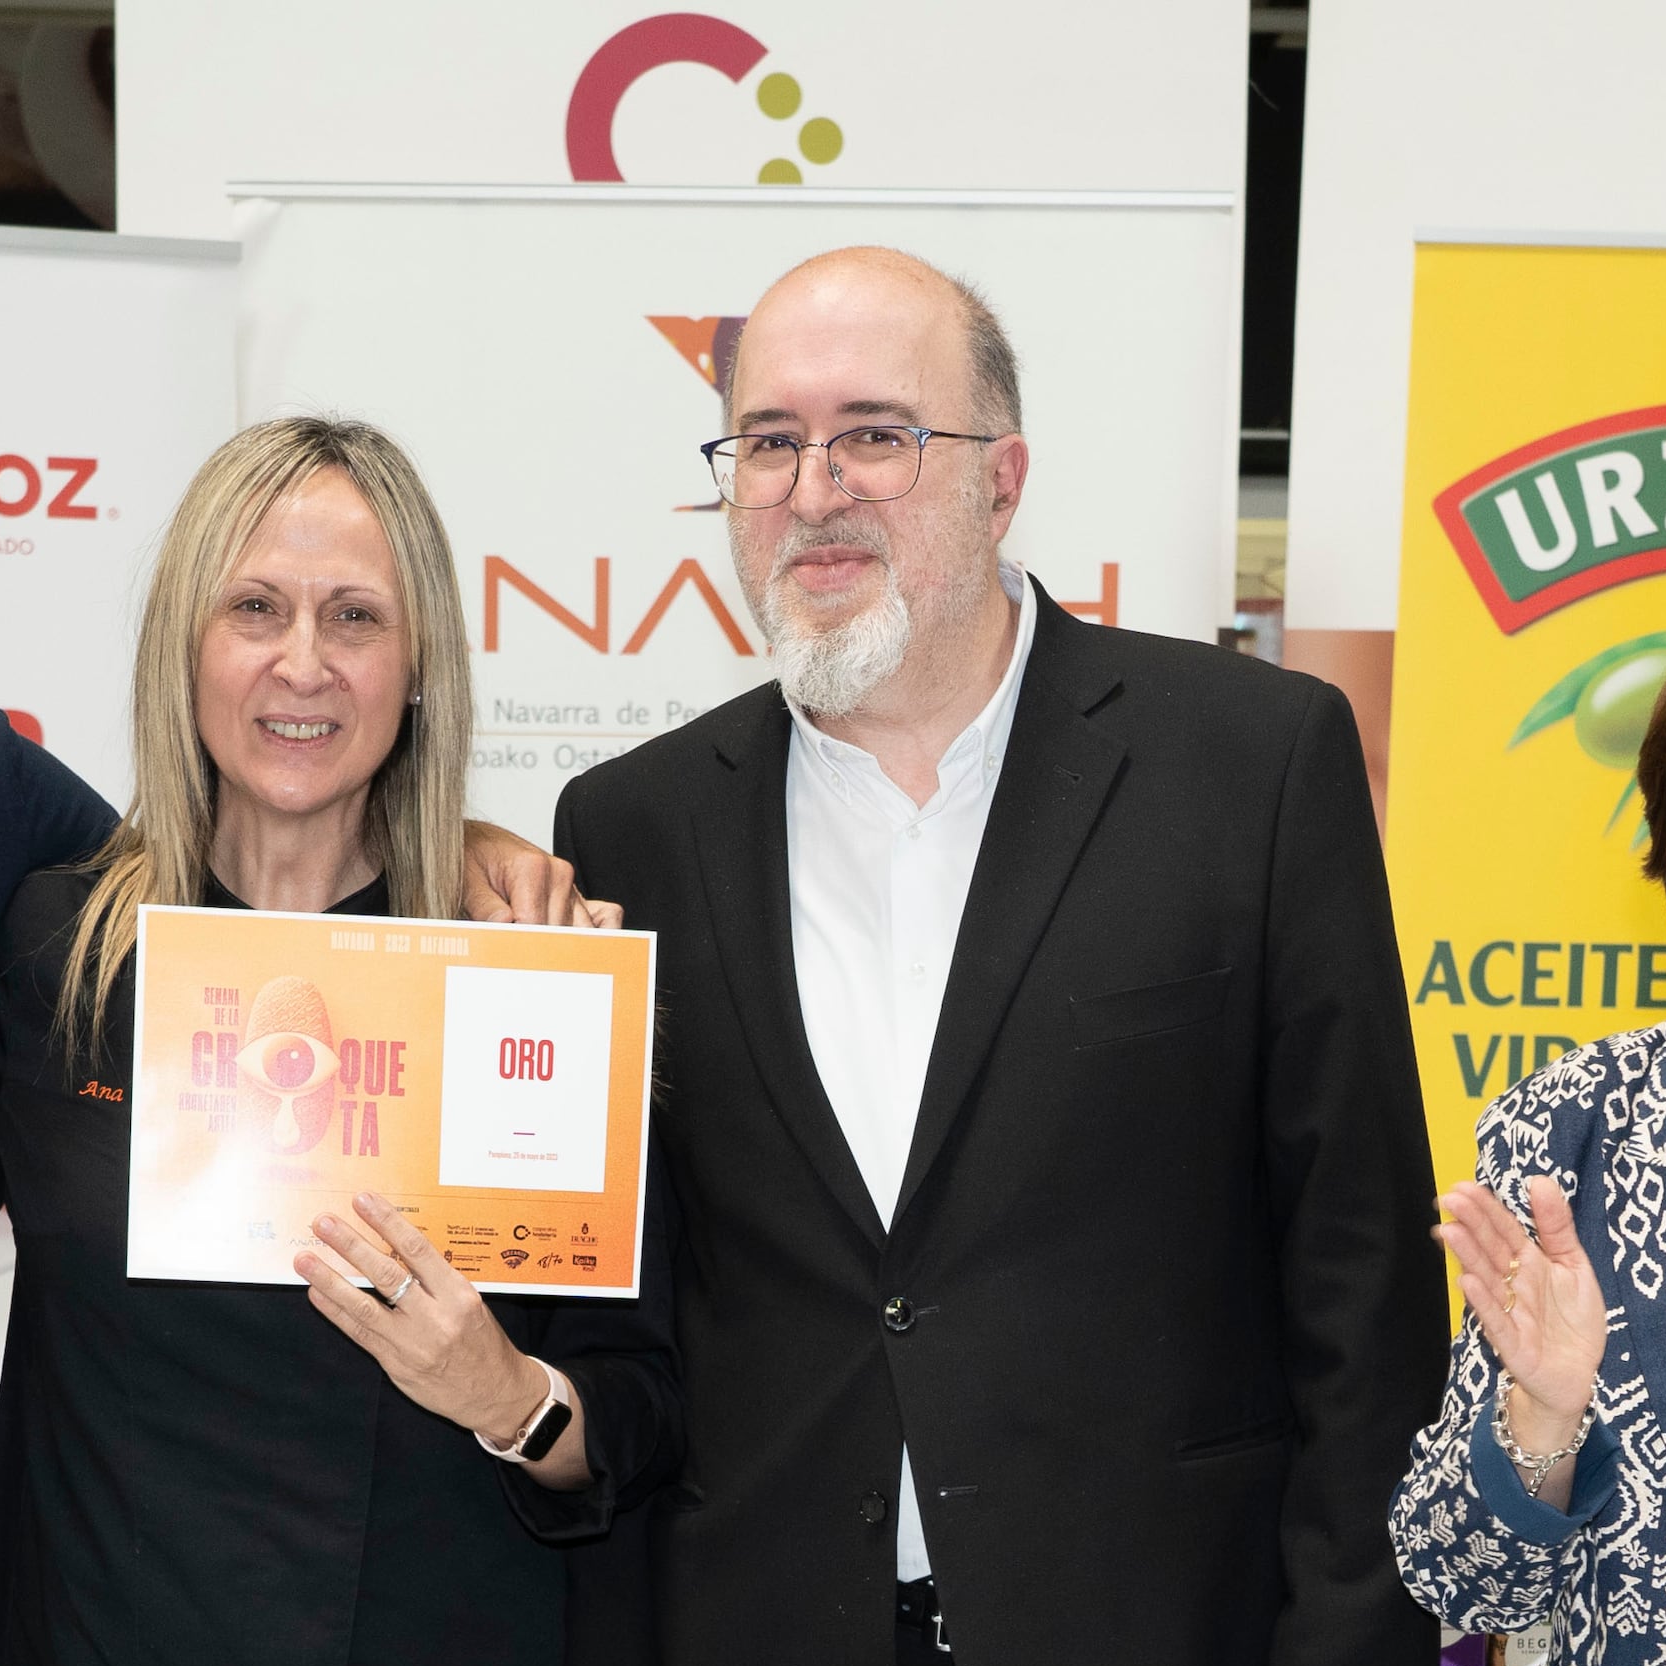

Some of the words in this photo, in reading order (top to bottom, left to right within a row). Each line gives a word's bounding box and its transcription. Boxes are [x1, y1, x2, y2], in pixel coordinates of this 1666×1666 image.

[494, 699, 600, 725] Navarra
[616, 702, 650, 725] de
[204, 986, 239, 1006] SEMANA
[214, 1007, 225, 1025] DE
[229, 1007, 239, 1026] LA
[191, 1031, 238, 1088] CR
[339, 1038, 406, 1096] QUE
[499, 1037, 555, 1082] ORO
[78, 1080, 124, 1102] Ana
[339, 1100, 380, 1156] TA
